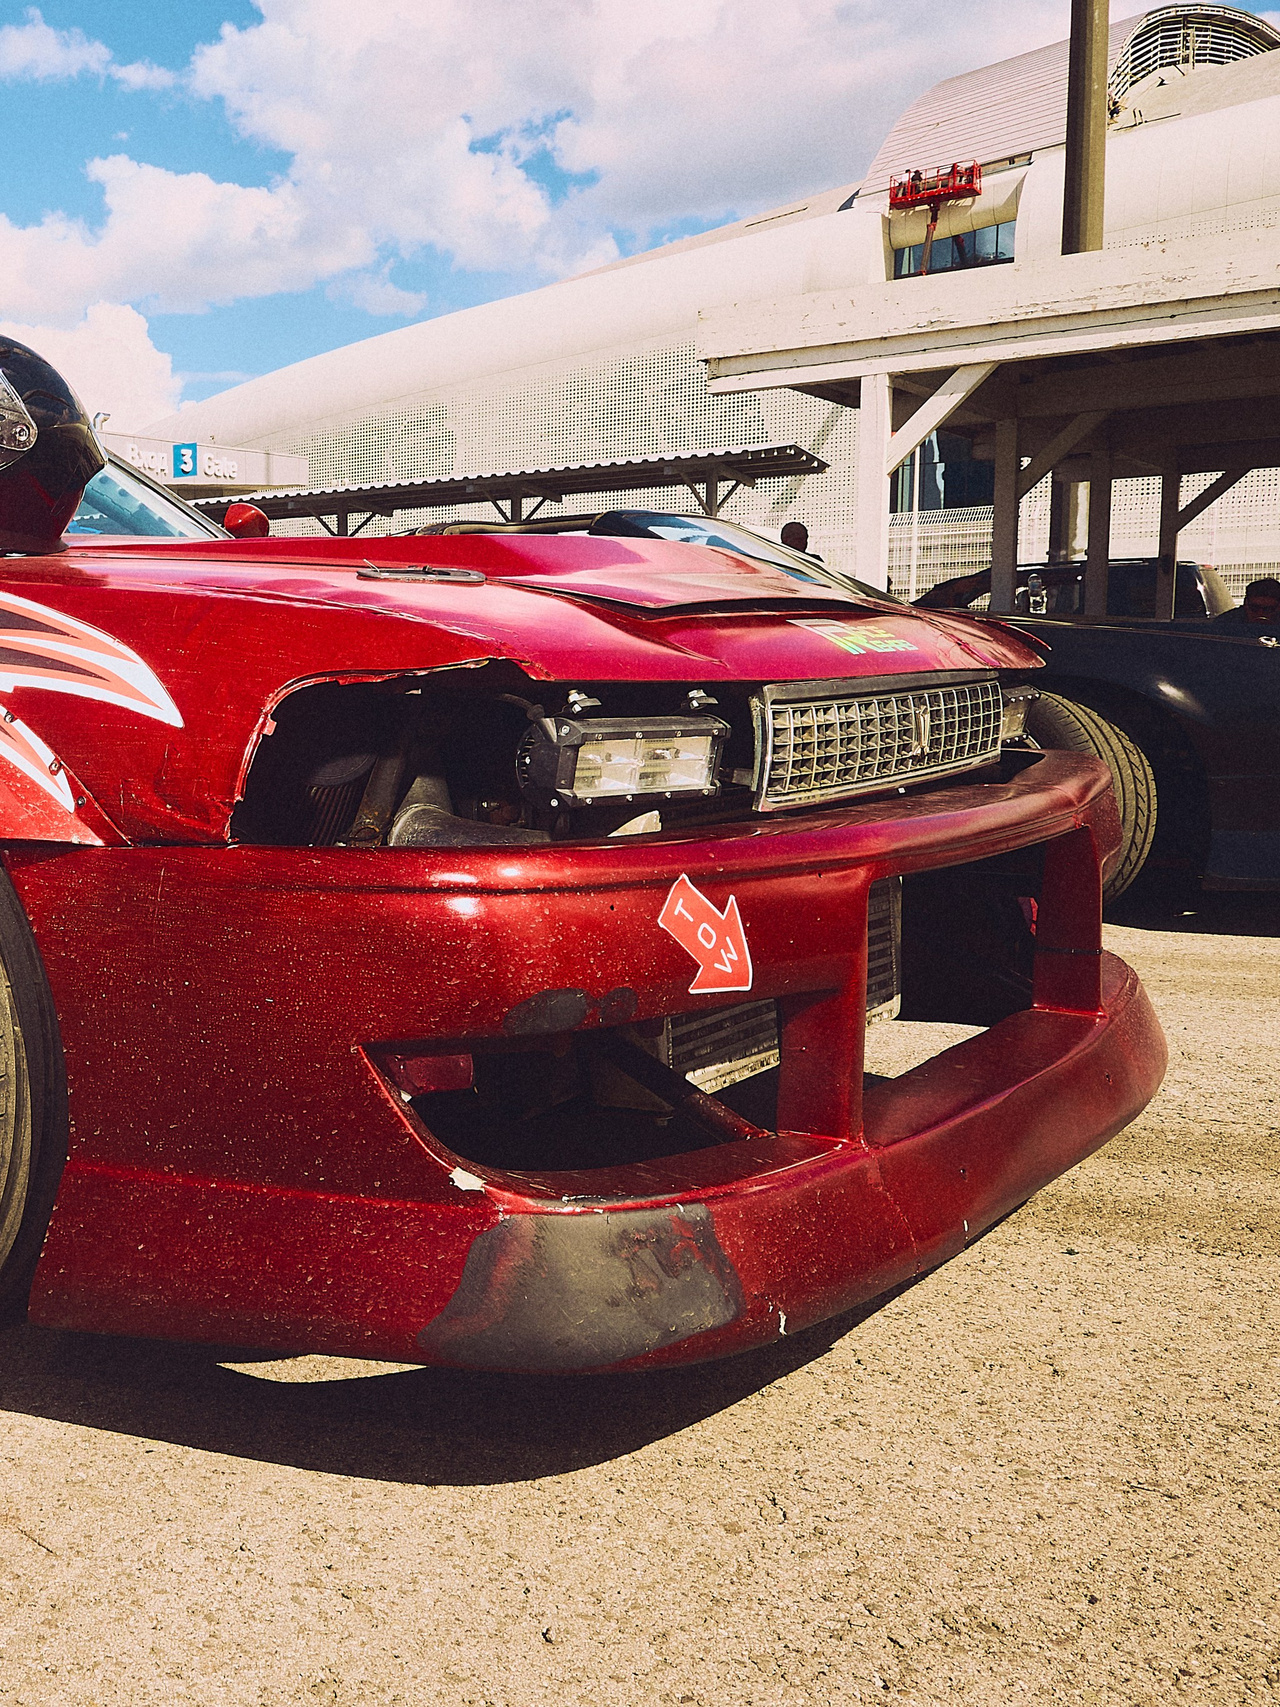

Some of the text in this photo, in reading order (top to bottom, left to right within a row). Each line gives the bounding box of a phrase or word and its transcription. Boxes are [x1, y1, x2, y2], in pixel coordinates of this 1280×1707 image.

[128, 443, 238, 480] Вход 3 Gate
[674, 898, 739, 974] TOW
